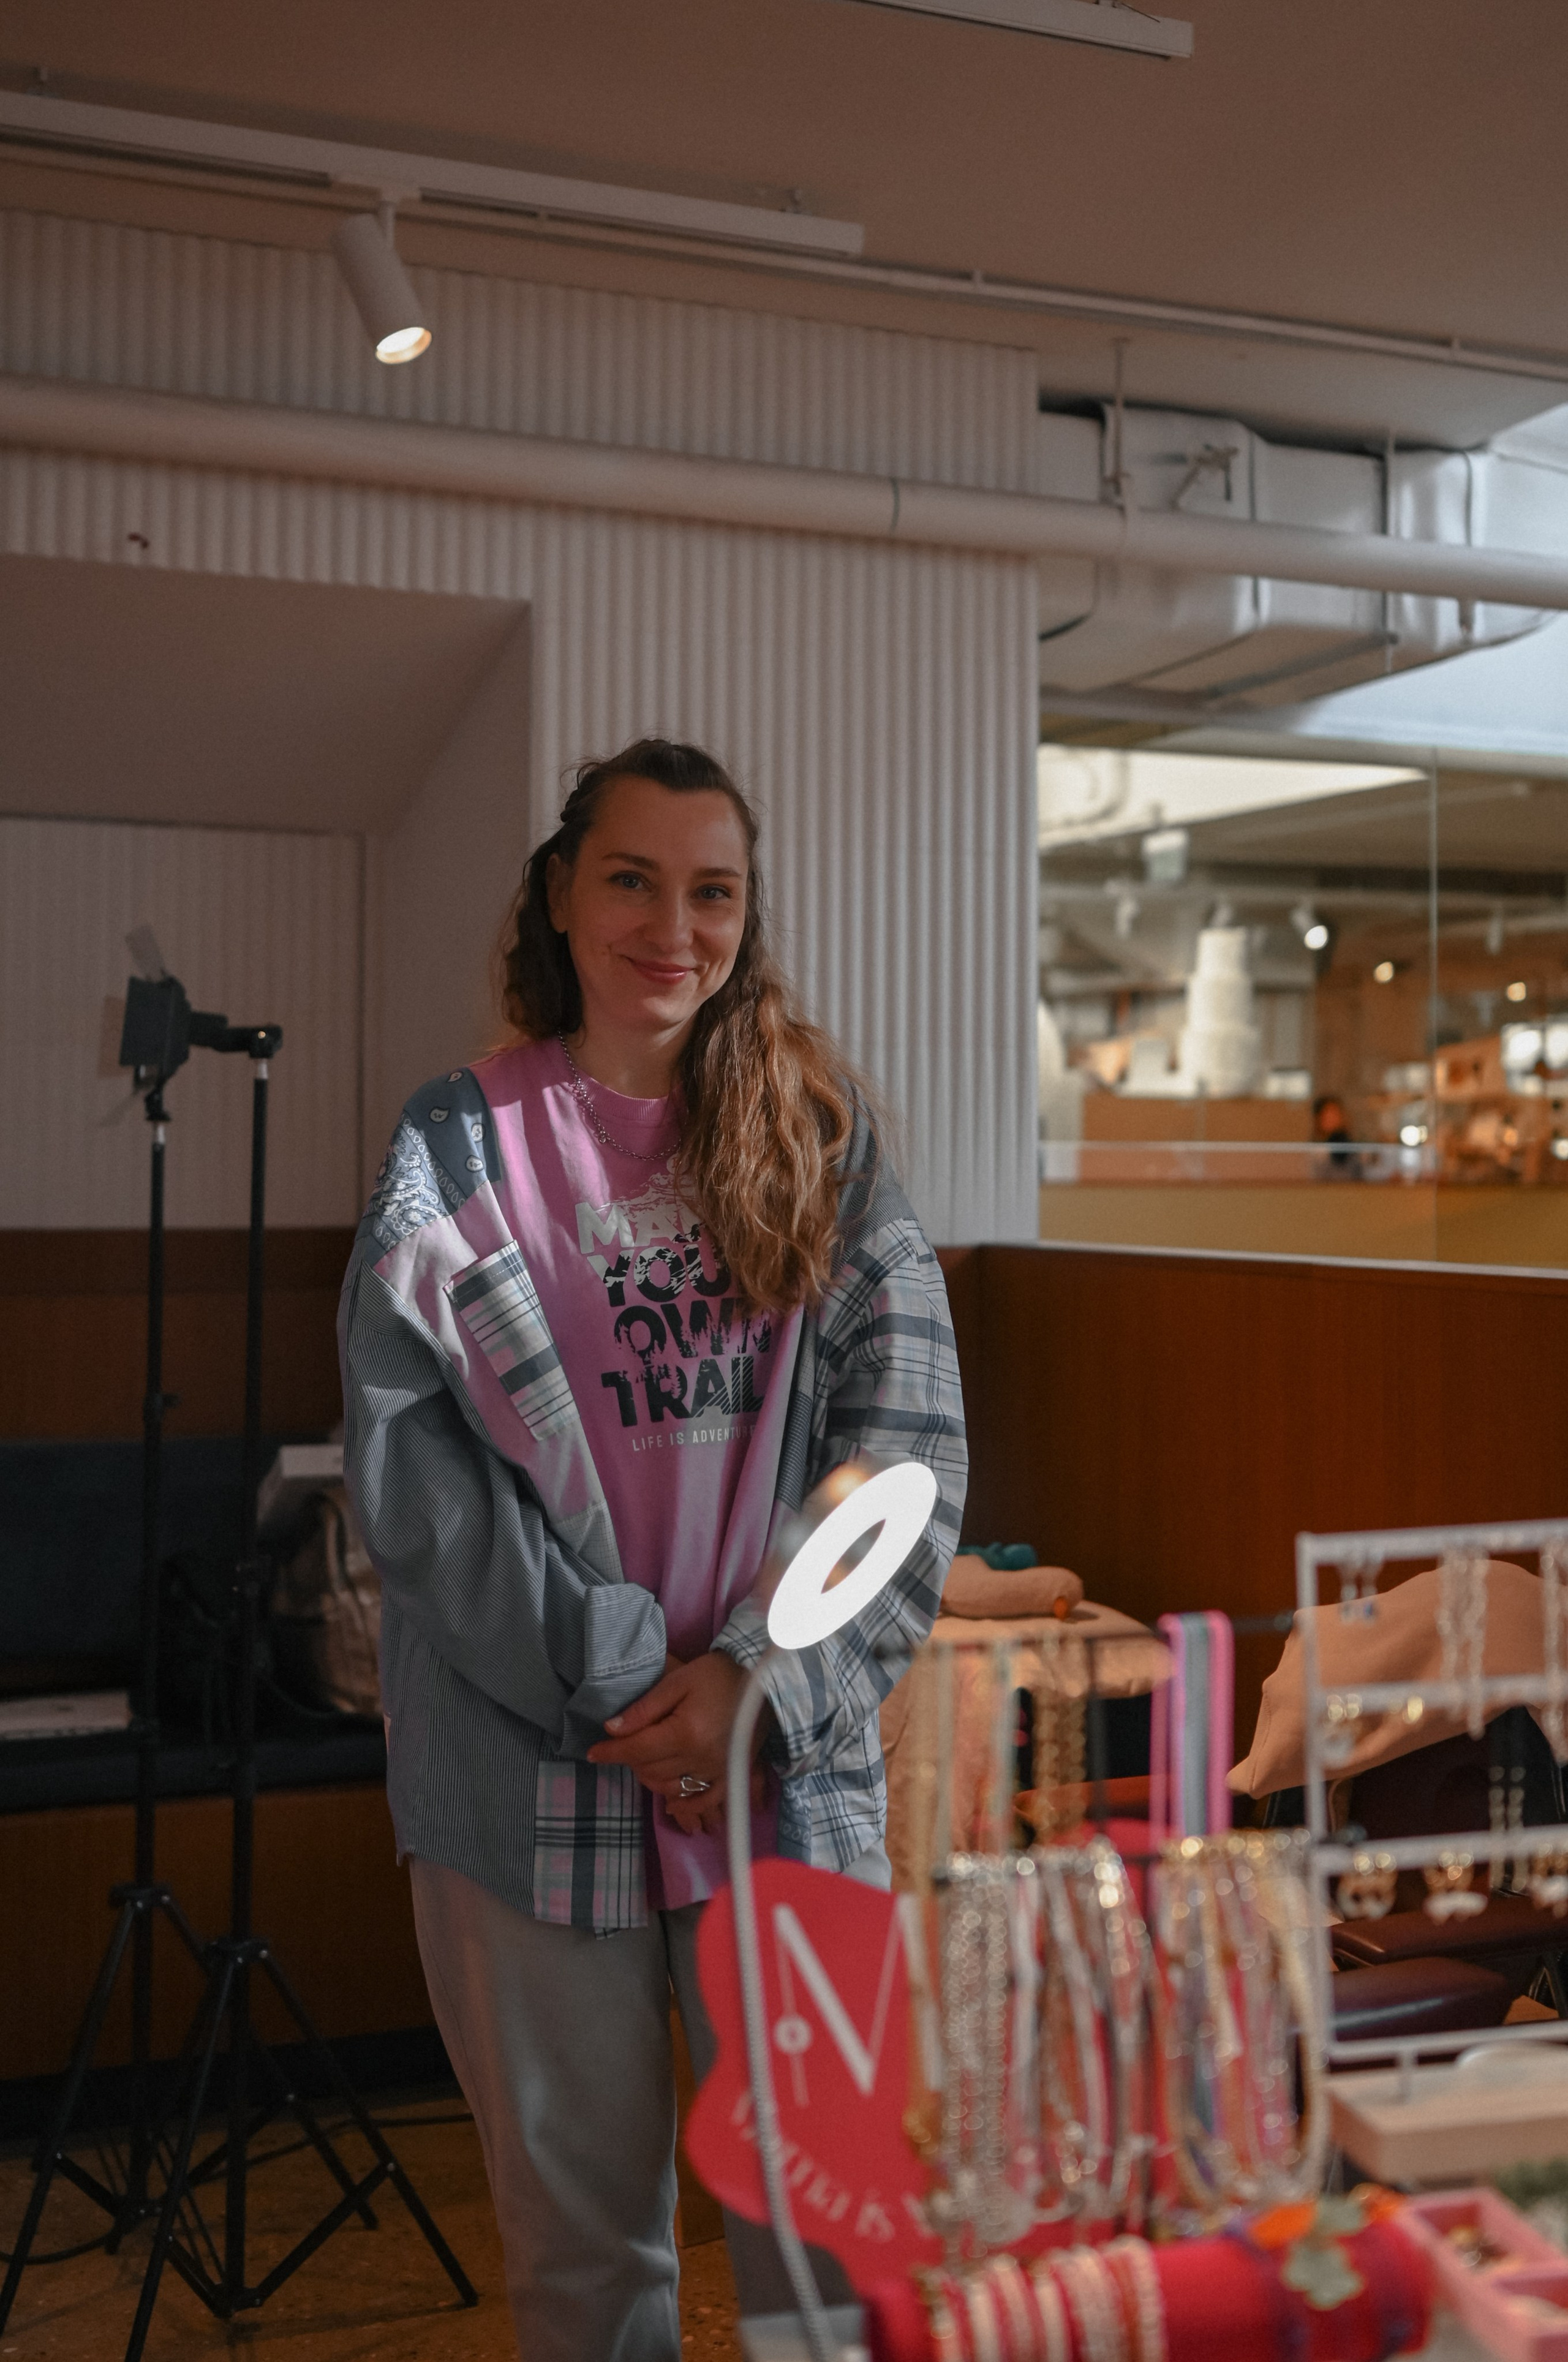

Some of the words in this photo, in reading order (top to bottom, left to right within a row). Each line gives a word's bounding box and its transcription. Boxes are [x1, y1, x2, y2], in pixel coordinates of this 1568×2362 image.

[601, 1355, 765, 1428] TRAIL
[632, 1435, 663, 1452] LIFE
[670, 1432, 685, 1445] IS
